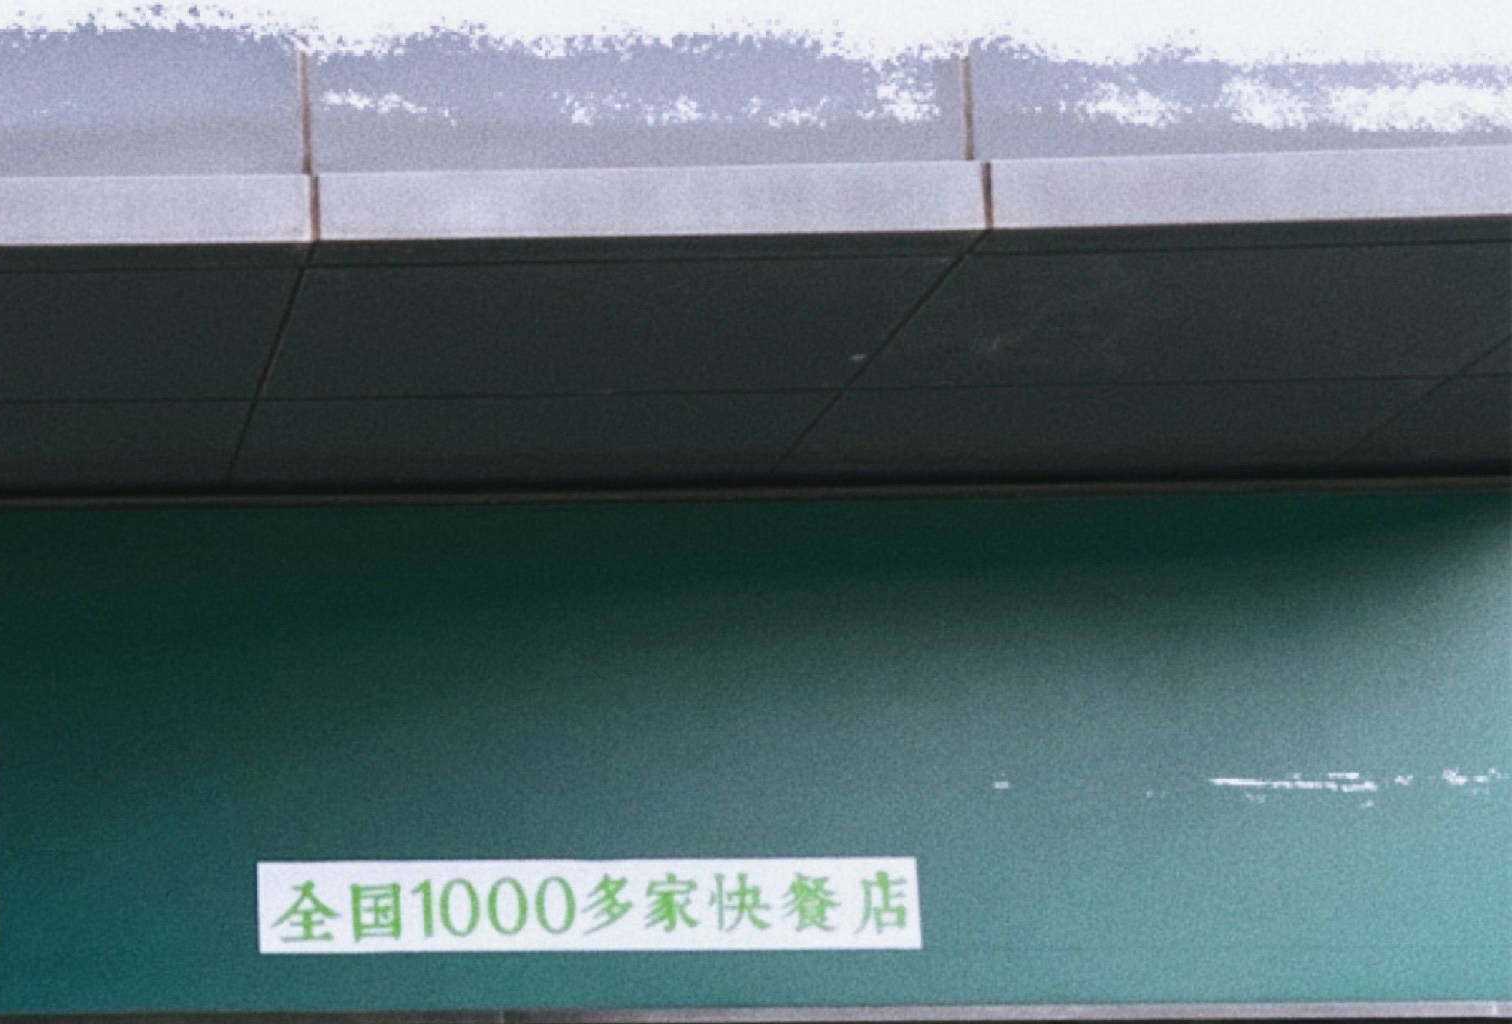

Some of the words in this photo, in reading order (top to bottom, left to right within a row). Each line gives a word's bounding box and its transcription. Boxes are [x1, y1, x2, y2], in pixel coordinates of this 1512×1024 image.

[273, 871, 908, 943] 全国1000多家快餐店
